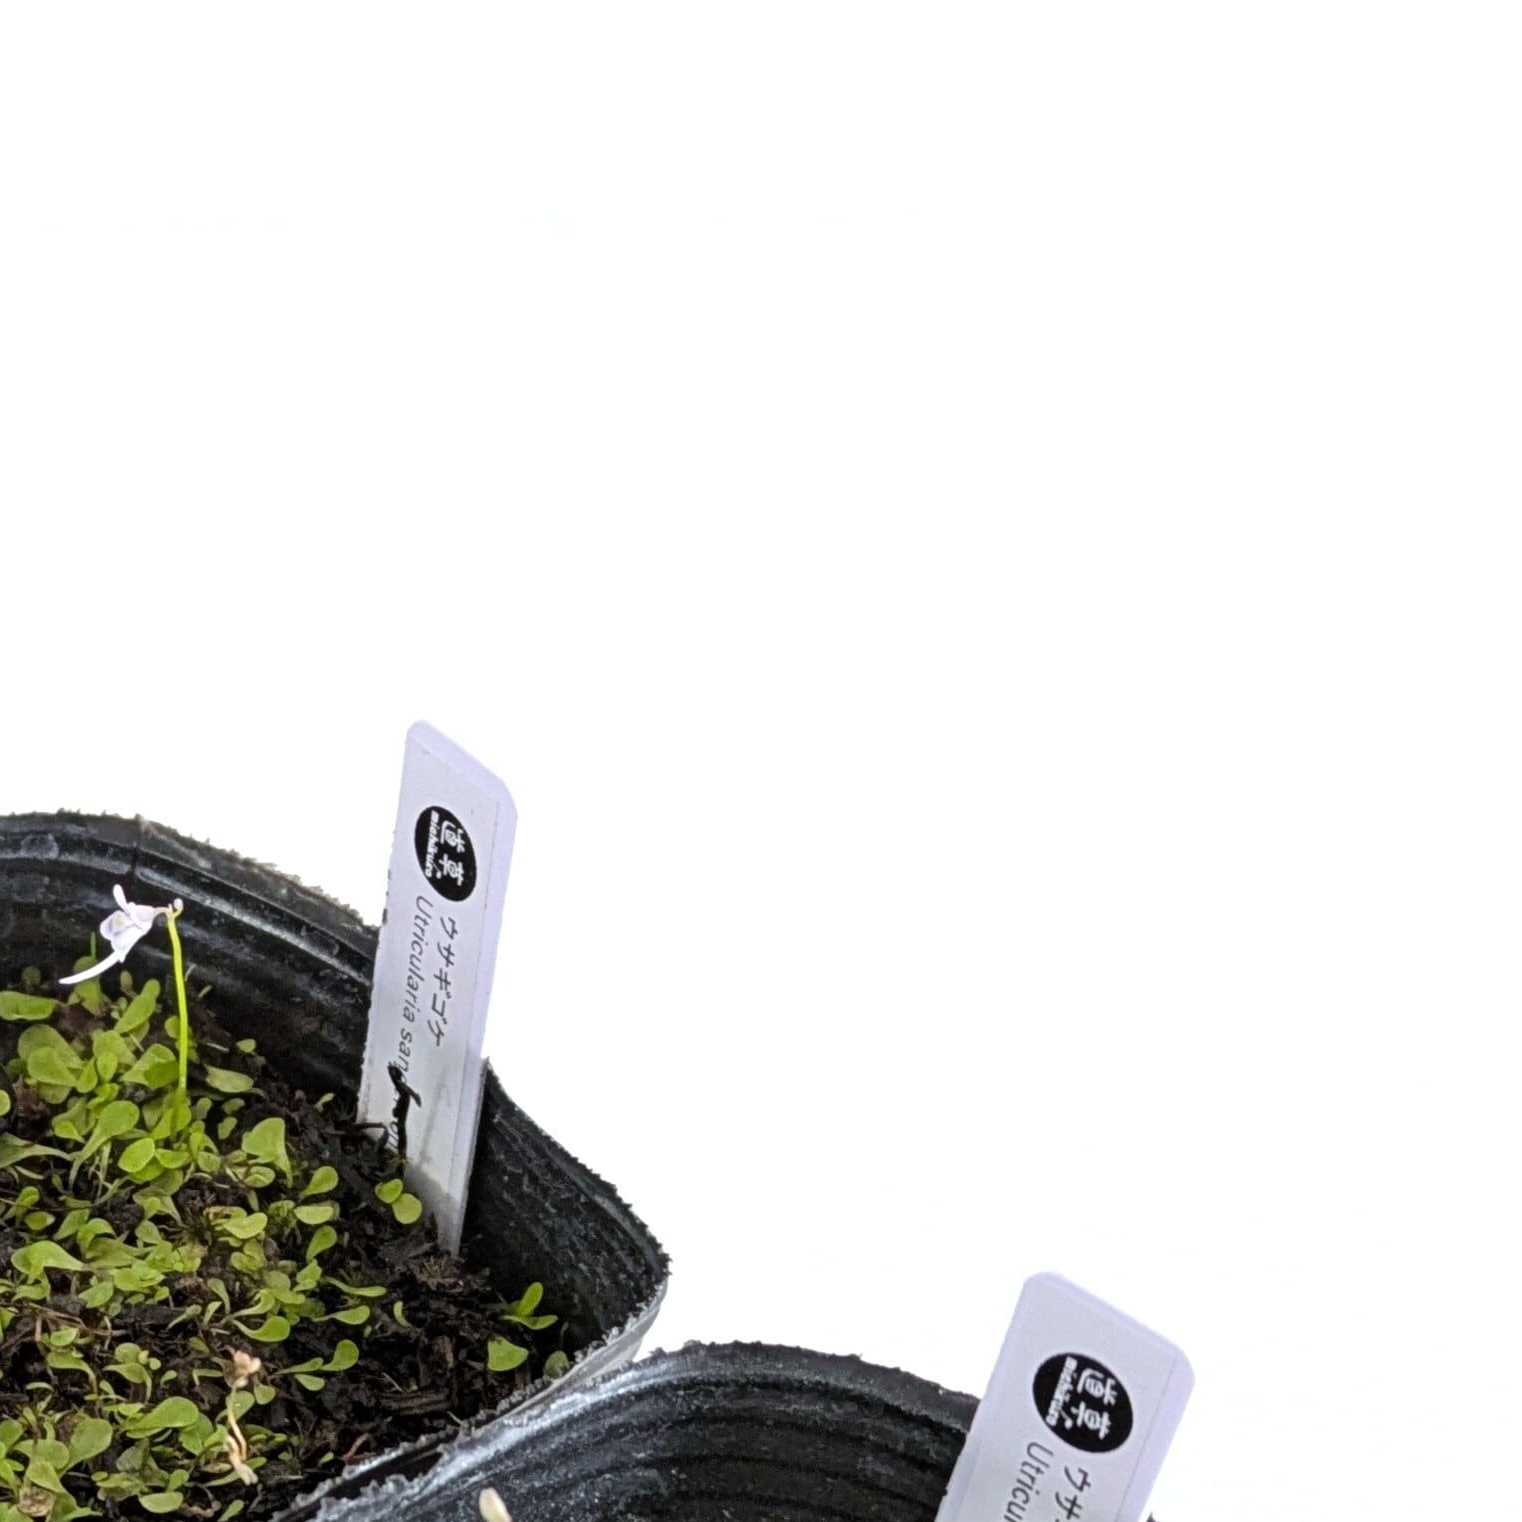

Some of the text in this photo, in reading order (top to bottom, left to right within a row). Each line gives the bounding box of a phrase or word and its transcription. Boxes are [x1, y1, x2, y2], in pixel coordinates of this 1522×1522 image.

[402, 895, 433, 1025] Utricularia
[427, 916, 459, 1047] ウサギゴケ
